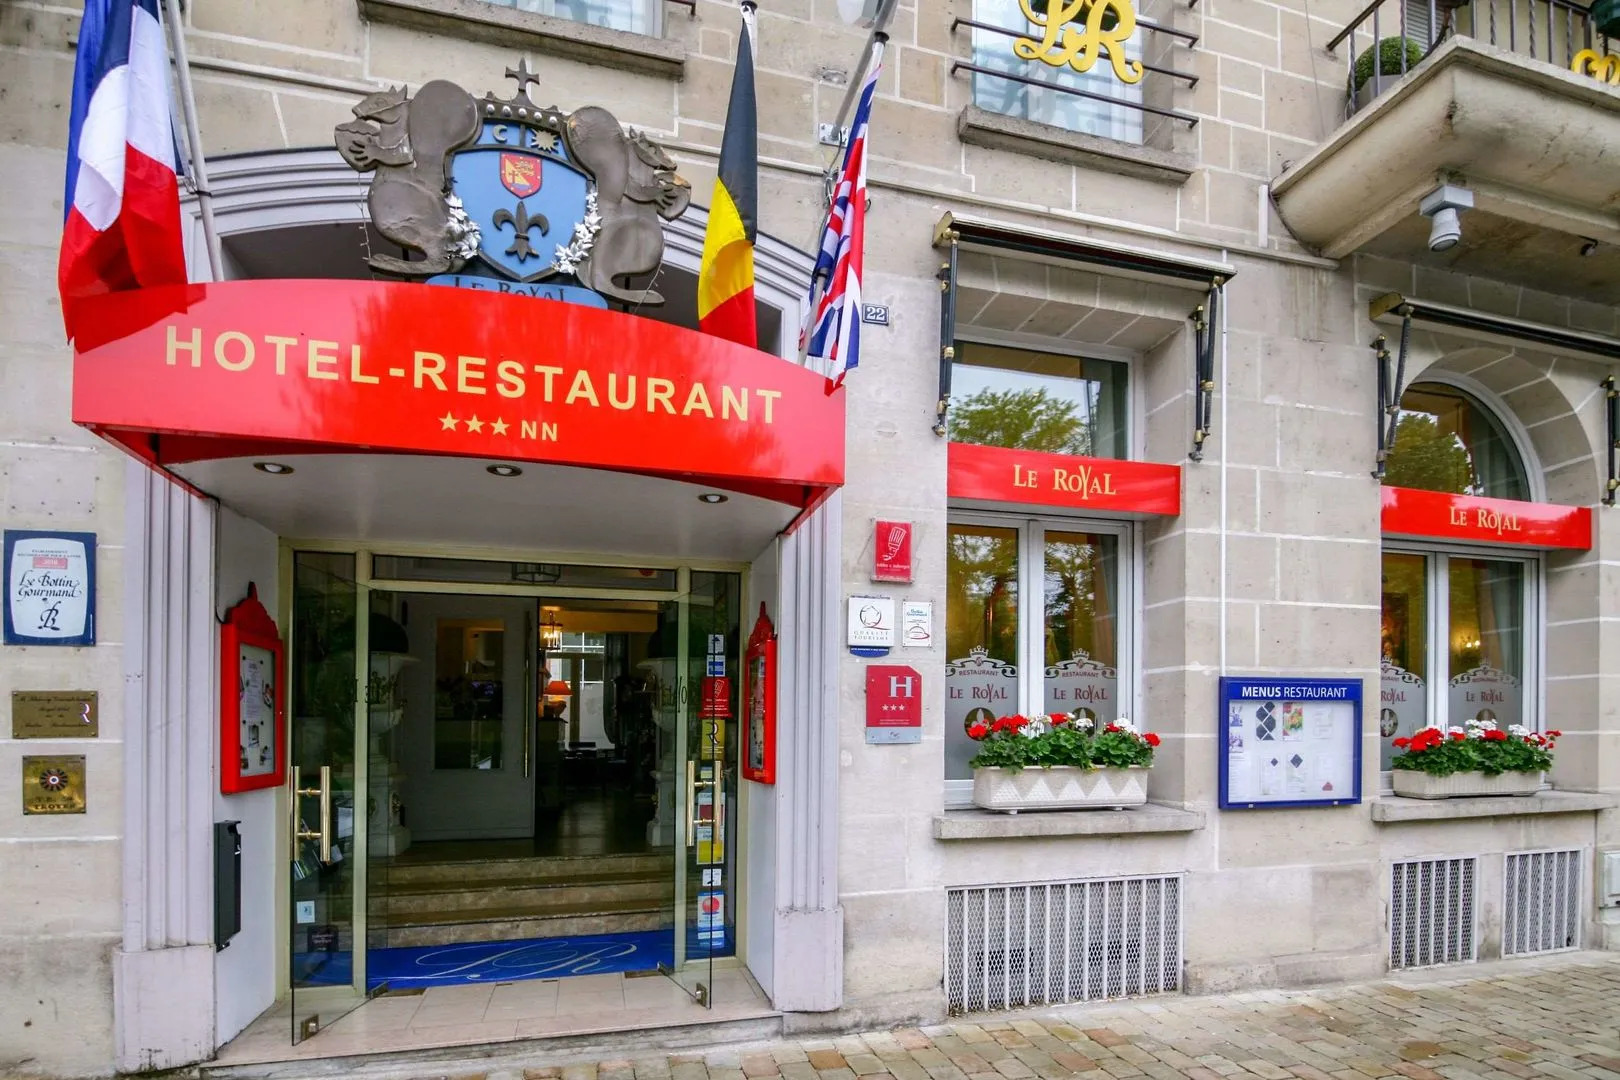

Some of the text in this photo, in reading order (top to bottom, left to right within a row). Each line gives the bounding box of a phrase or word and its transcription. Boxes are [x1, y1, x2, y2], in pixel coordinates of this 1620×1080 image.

[866, 306, 886, 321] 22
[166, 325, 782, 424] HOTEL-RESTAURANT
[520, 420, 558, 442] NN
[1053, 465, 1117, 500] ROYAL
[1477, 508, 1521, 536] ROYAL
[38, 571, 80, 588] Bottin
[16, 584, 82, 602] Gourmand
[958, 669, 999, 678] RESTAURANT
[1061, 671, 1099, 679] RESTAURANT
[888, 675, 915, 699] H
[972, 683, 1008, 703] ROYAL
[1074, 685, 1108, 703] ROYAL
[1242, 686, 1347, 698] MENUS RESTAURANT
